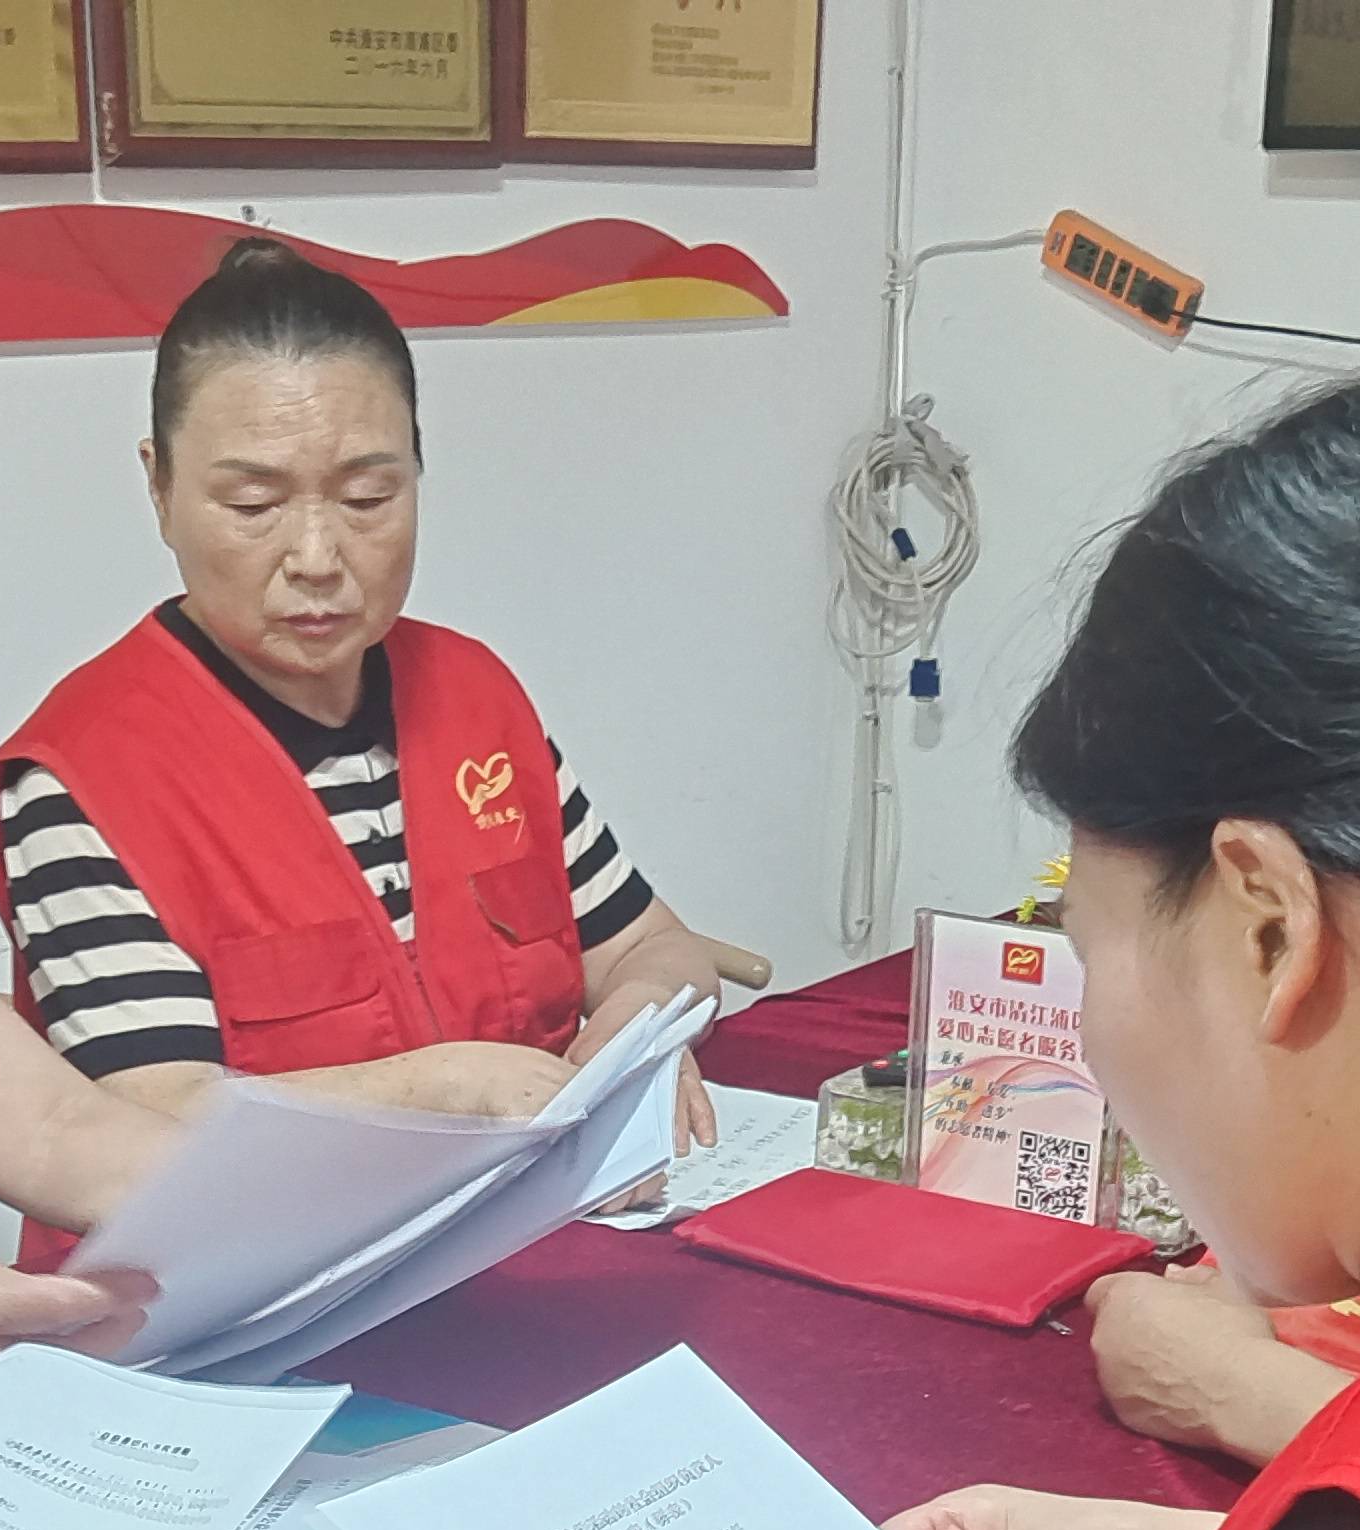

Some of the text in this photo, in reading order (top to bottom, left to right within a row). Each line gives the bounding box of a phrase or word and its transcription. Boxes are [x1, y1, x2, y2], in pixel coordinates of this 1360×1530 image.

[937, 1017, 1081, 1062] 爱心志愿者服务
